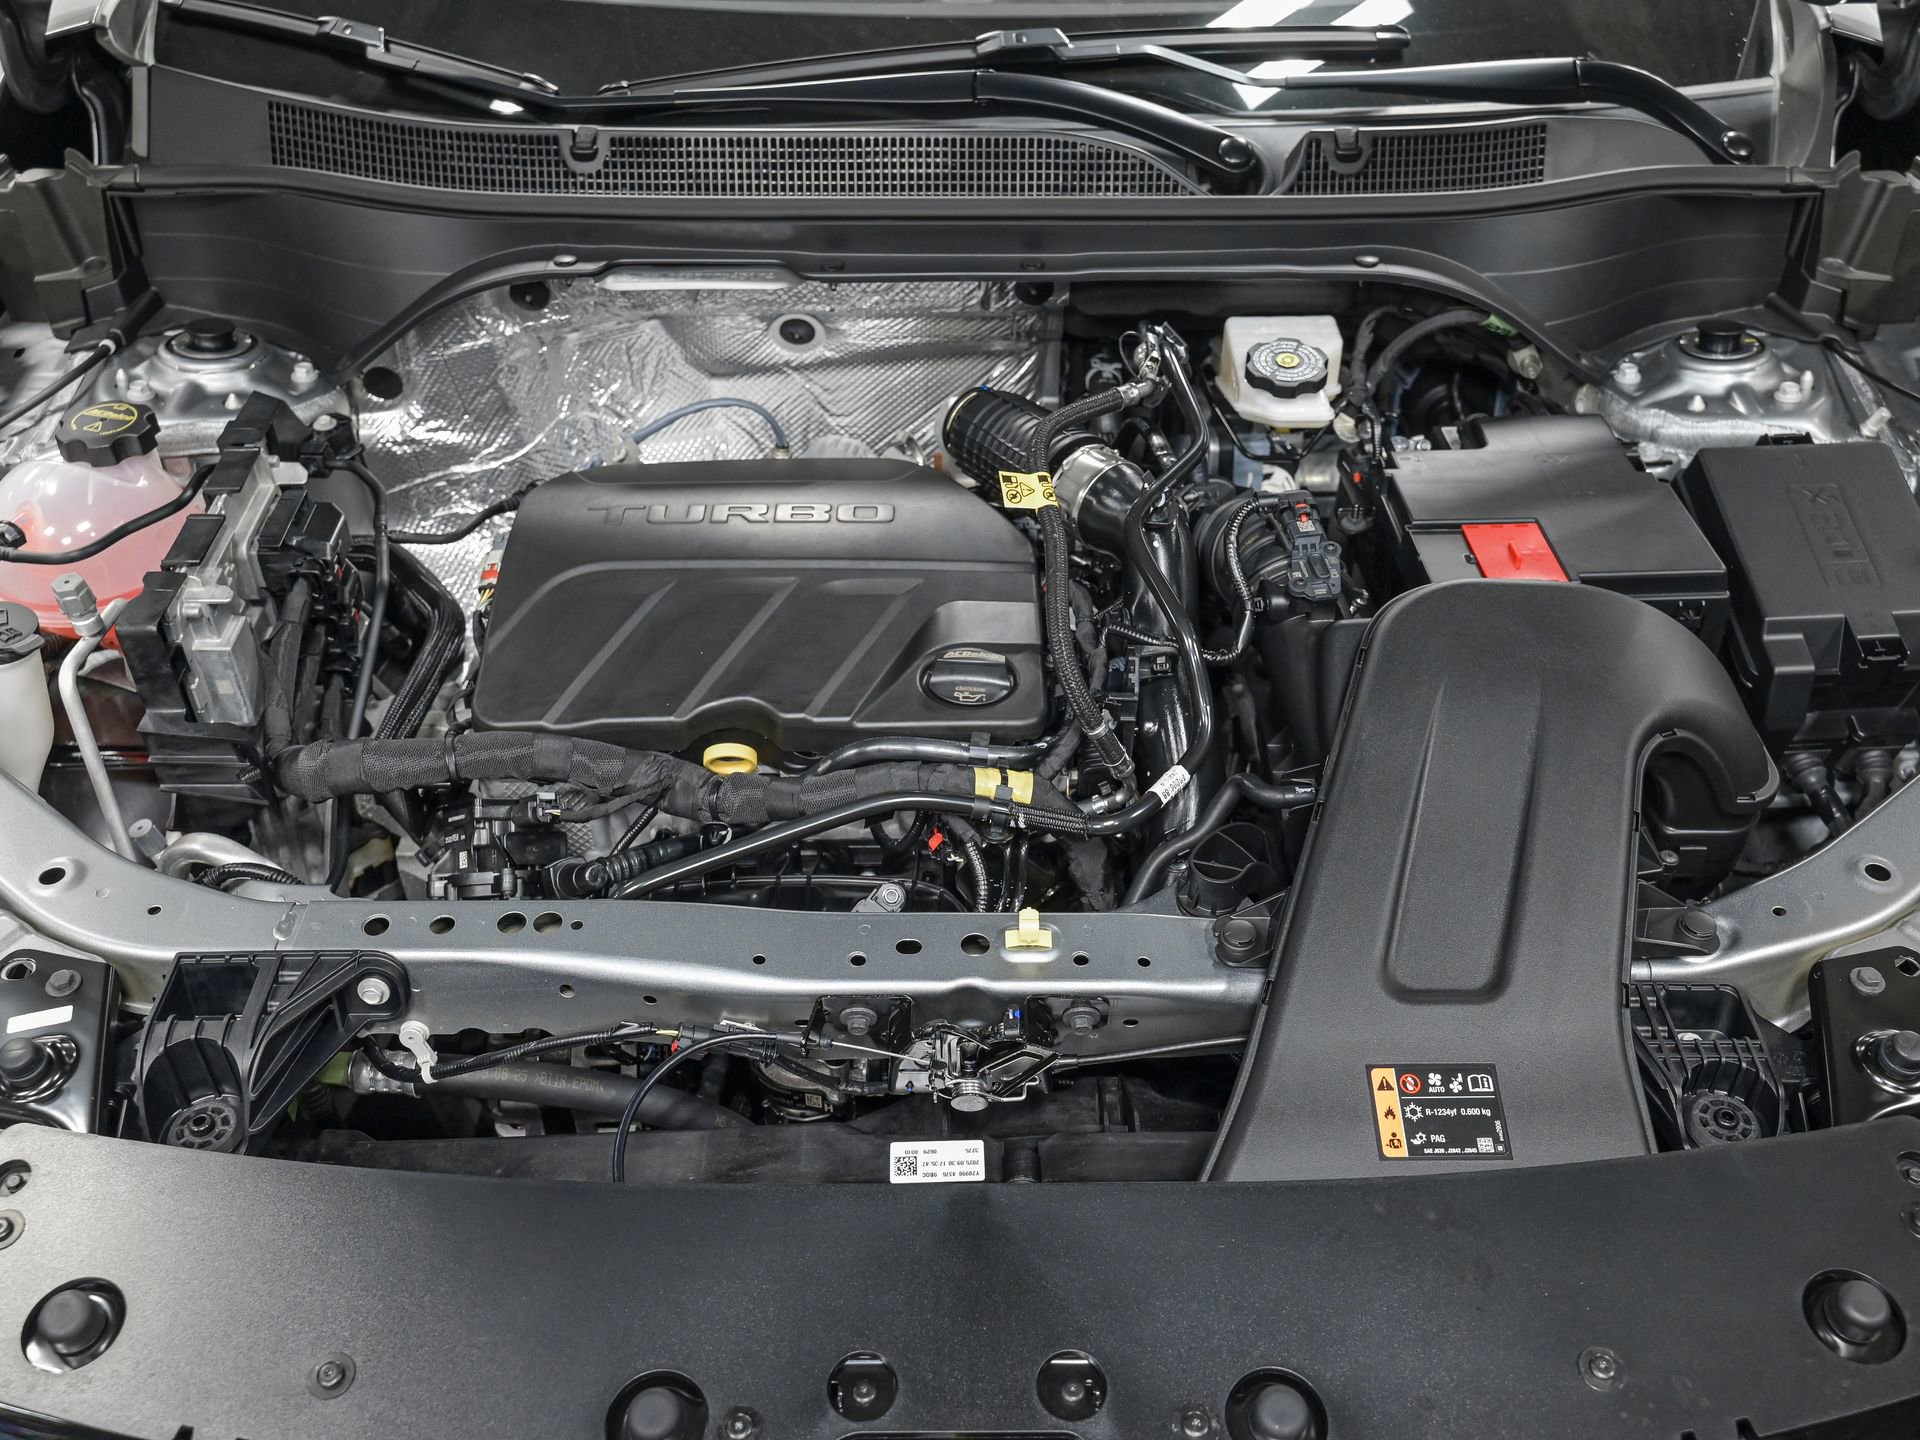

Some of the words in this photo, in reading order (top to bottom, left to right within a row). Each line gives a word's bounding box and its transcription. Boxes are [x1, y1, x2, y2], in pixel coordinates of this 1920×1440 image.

[587, 503, 896, 525] TURBO
[1425, 1108, 1457, 1117] R-1234yf
[1460, 1108, 1480, 1116] 0.600
[1481, 1108, 1491, 1117] kg
[1430, 1135, 1446, 1143] PAG
